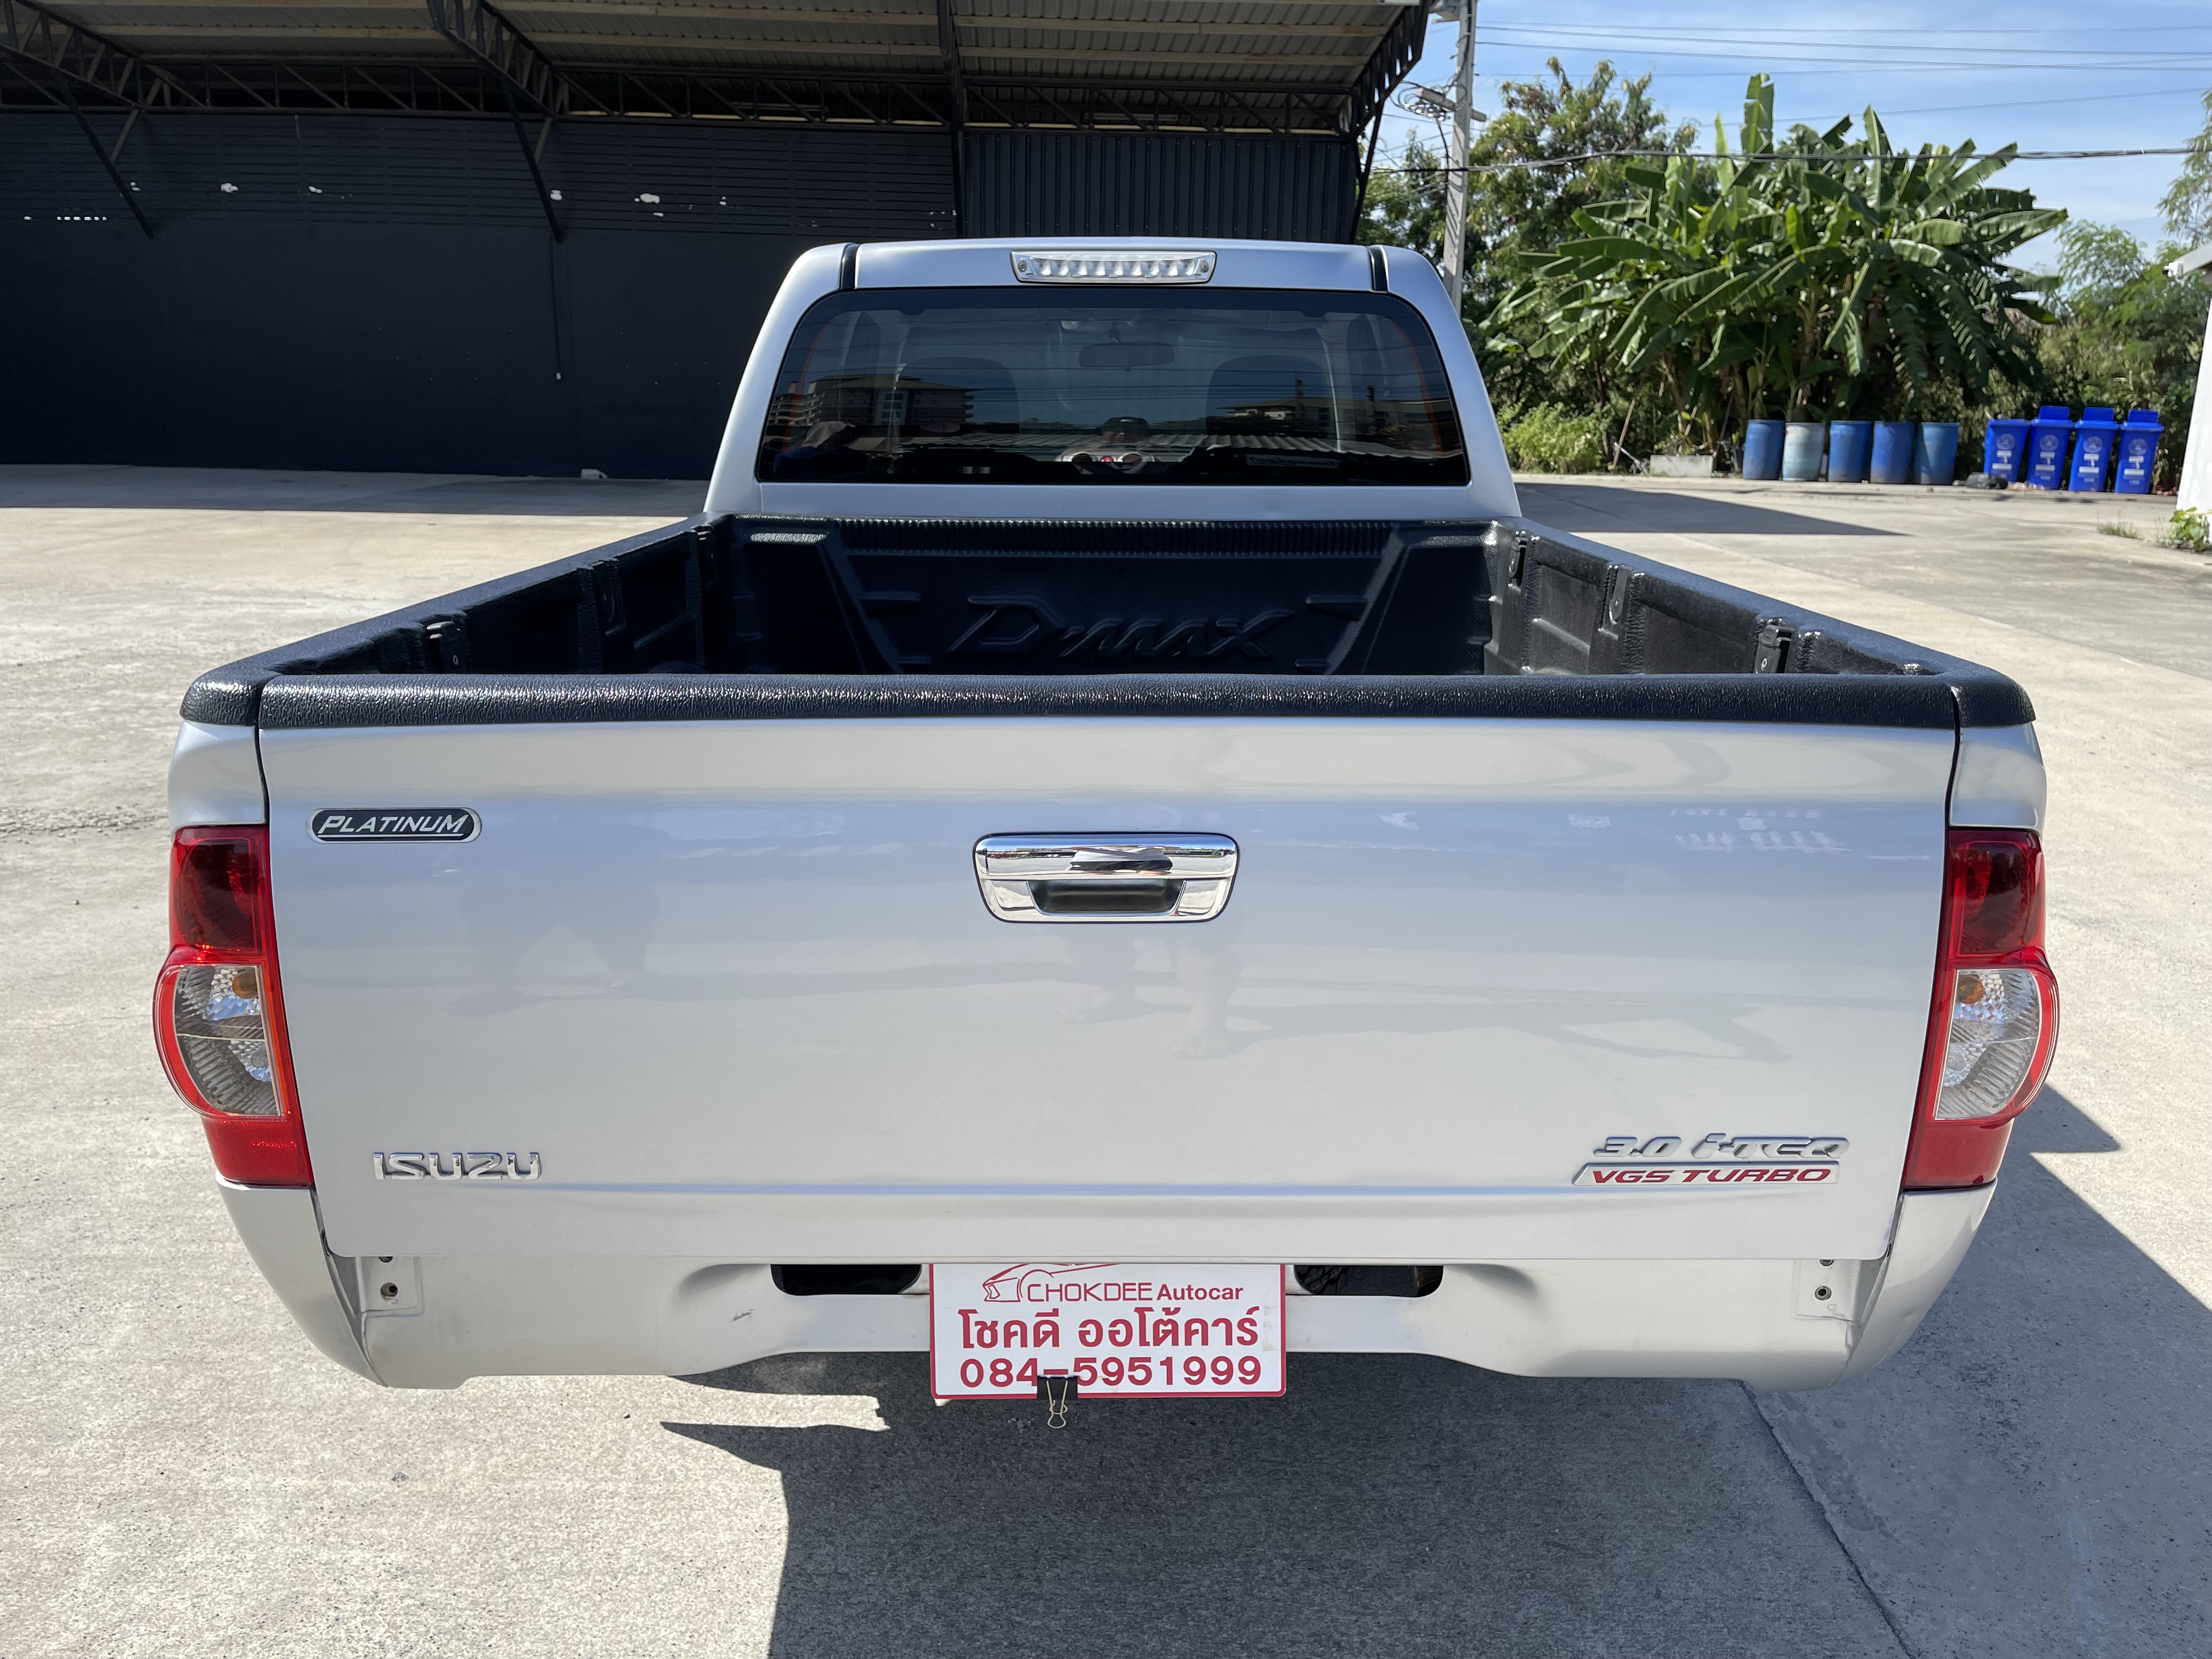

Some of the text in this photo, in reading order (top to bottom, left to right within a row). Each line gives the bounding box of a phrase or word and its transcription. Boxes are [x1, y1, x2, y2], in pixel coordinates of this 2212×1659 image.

[318, 815, 468, 834] PLATINUM
[1593, 1136, 1682, 1158] 3.0
[373, 1152, 541, 1180] ISUZU
[1593, 1168, 1831, 1183] VGS TURBO
[1027, 1282, 1244, 1302] CHOKDEE Autocar
[958, 1306, 1260, 1348] โชคดี ออโต้คาร์
[960, 1356, 1262, 1387] 084-5951999
